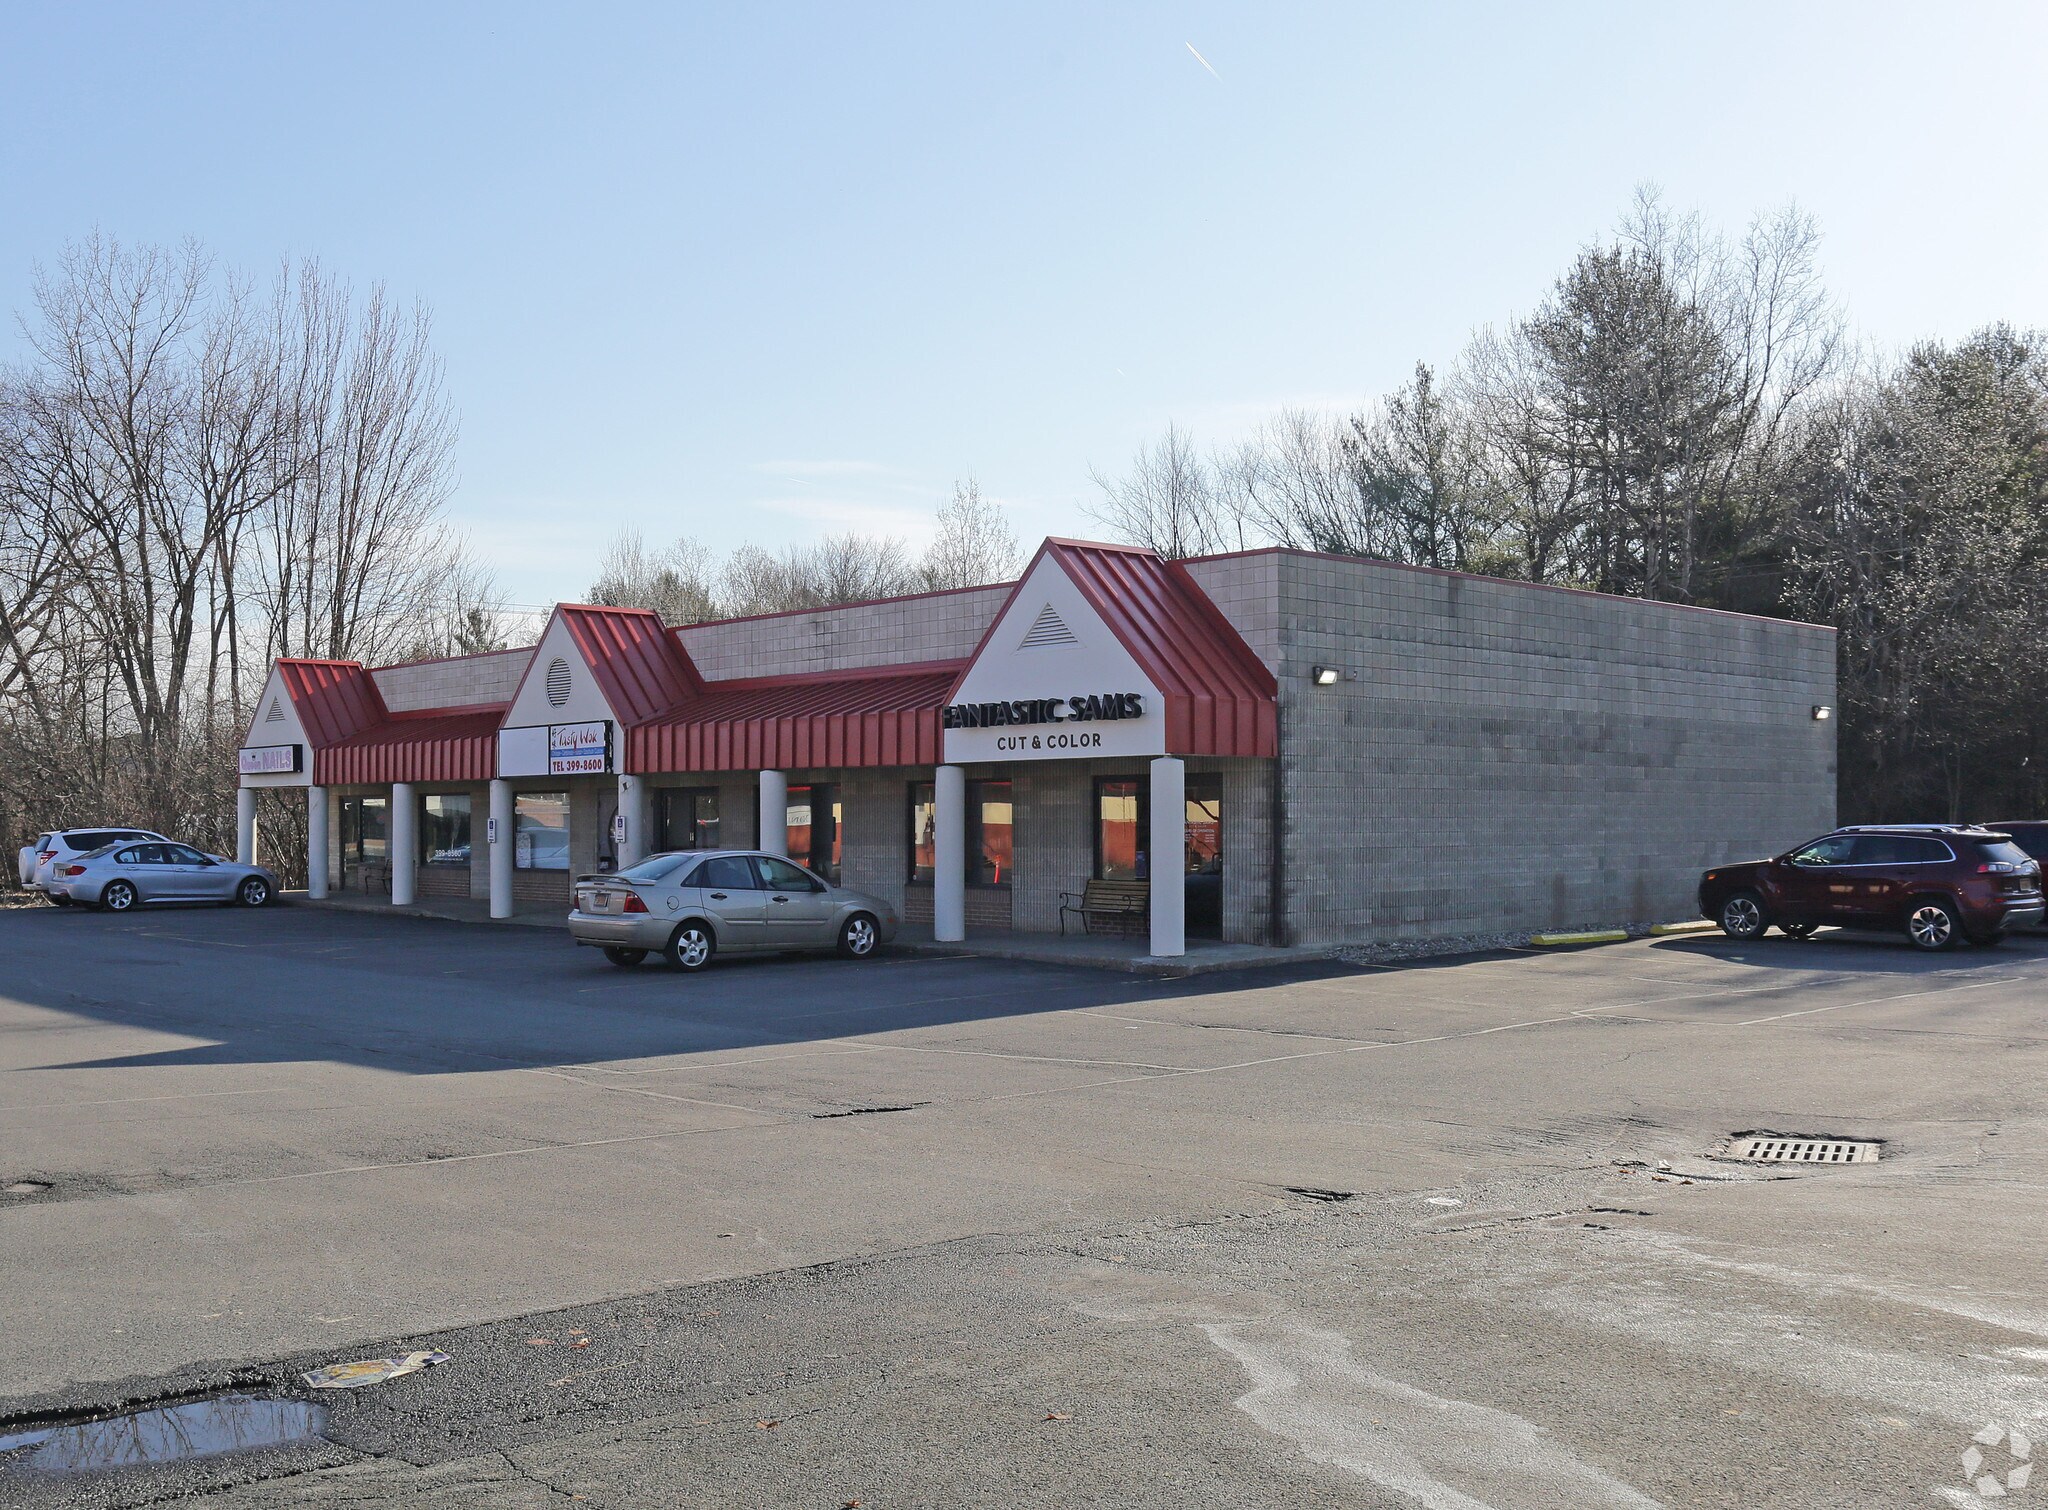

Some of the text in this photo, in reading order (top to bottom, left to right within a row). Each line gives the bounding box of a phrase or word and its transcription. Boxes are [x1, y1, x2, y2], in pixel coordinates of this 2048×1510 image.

[943, 693, 1142, 729] FANTASTIC SAMS
[557, 727, 577, 752] Tasty
[580, 728, 597, 744] Wok
[997, 733, 1101, 750] CUT & COLOR
[263, 750, 291, 769] NAILS
[553, 761, 564, 772] TEL
